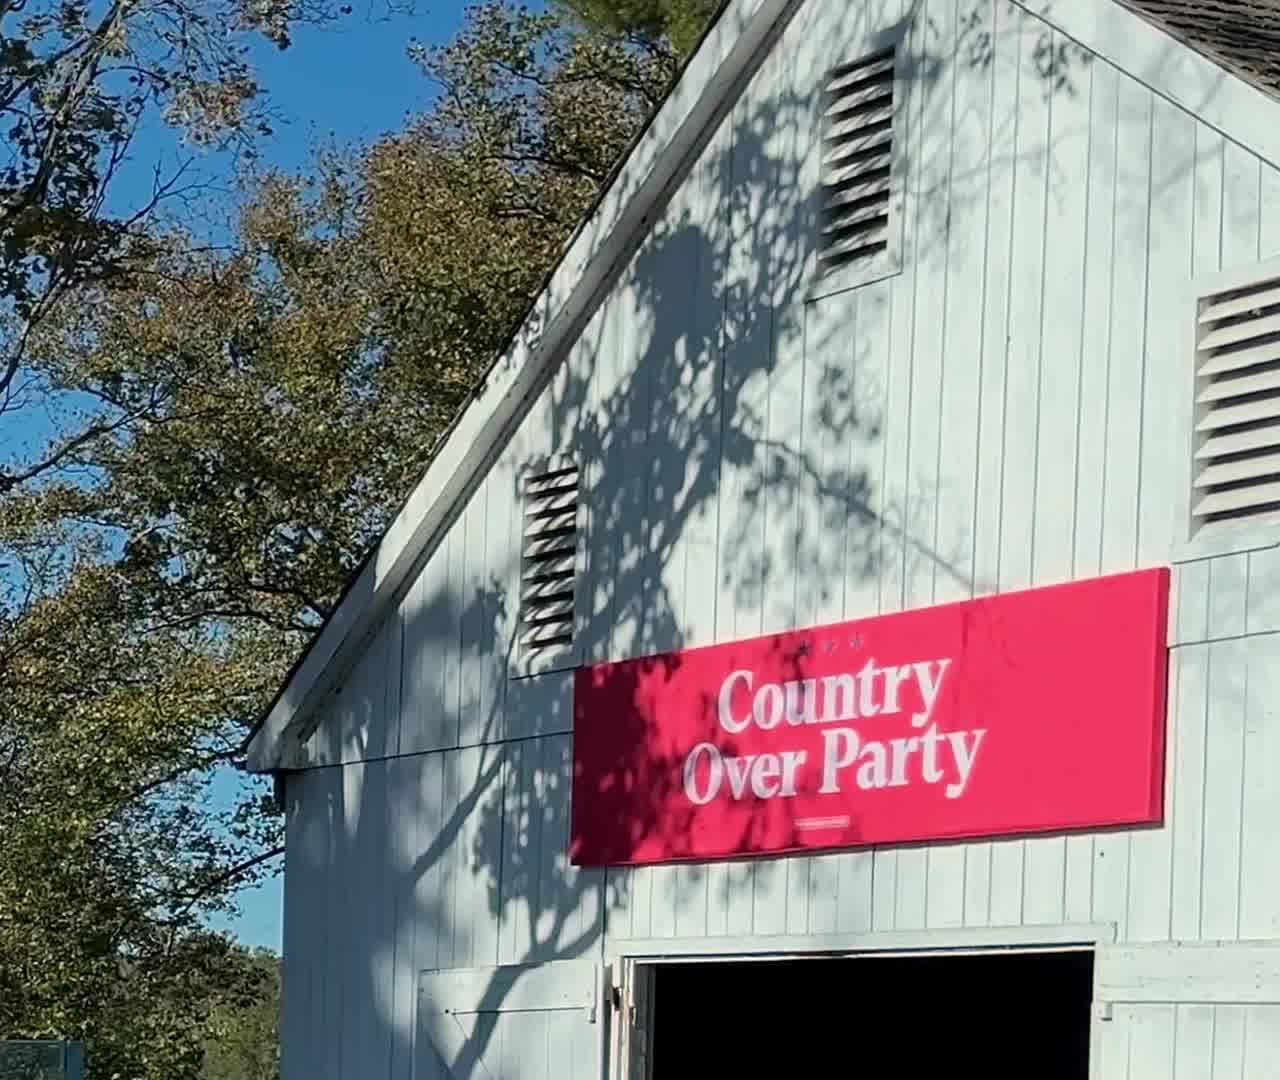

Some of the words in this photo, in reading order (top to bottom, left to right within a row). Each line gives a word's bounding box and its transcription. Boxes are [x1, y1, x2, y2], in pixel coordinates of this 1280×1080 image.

[717, 656, 952, 736] Country
[683, 741, 808, 806] Over
[818, 725, 988, 800] Party
